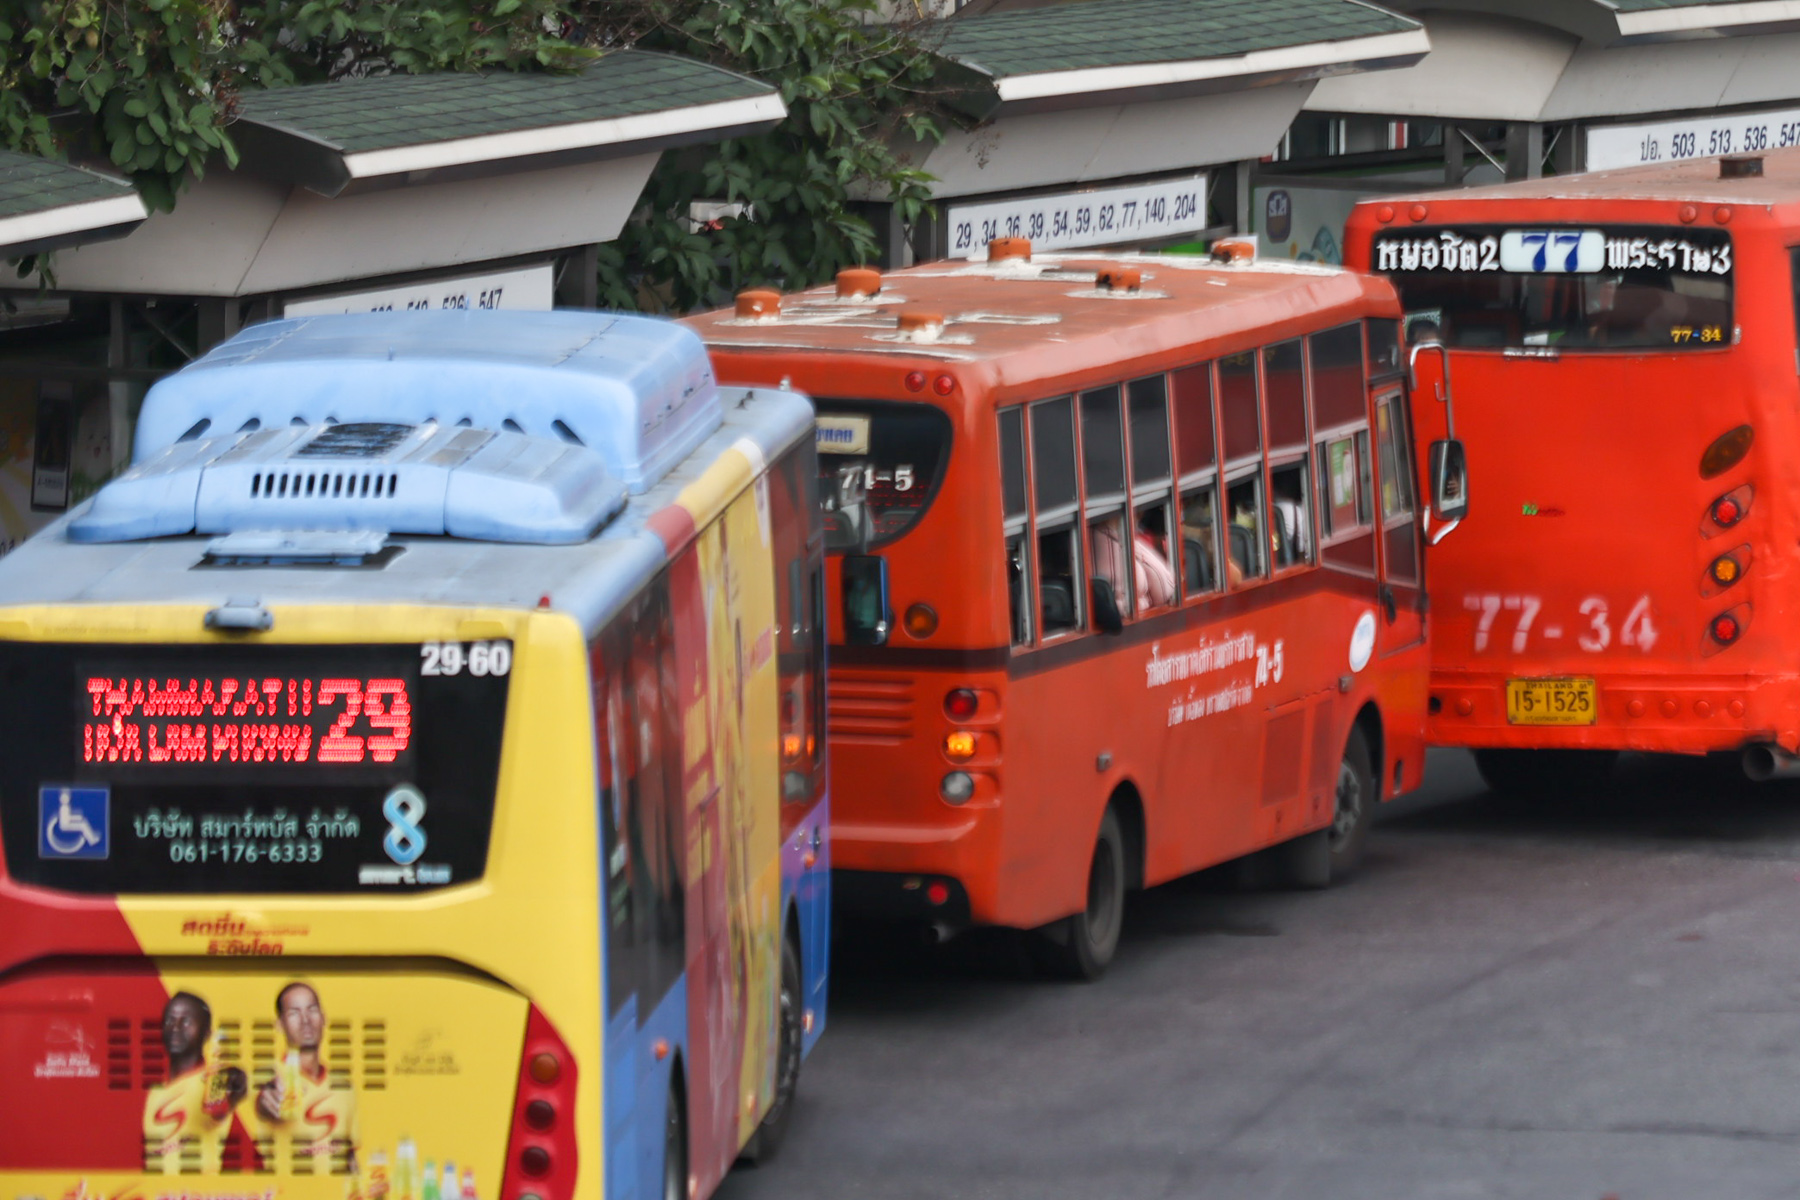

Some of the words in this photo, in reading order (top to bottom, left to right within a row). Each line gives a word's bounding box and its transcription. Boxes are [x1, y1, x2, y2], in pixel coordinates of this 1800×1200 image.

[1174, 194, 1196, 220] 204
[1376, 230, 1499, 274] หมอชิต2
[1521, 230, 1584, 273] 77
[1671, 325, 1722, 343] 77-34
[421, 644, 511, 677] 29-60
[1514, 689, 1590, 713] 15-1525
[317, 678, 411, 762] 29
[134, 806, 194, 839] บริษัท
[201, 806, 298, 838] สมาร์ทบัส
[306, 806, 360, 838] จำกัด
[169, 842, 323, 865] 061-176-6333
